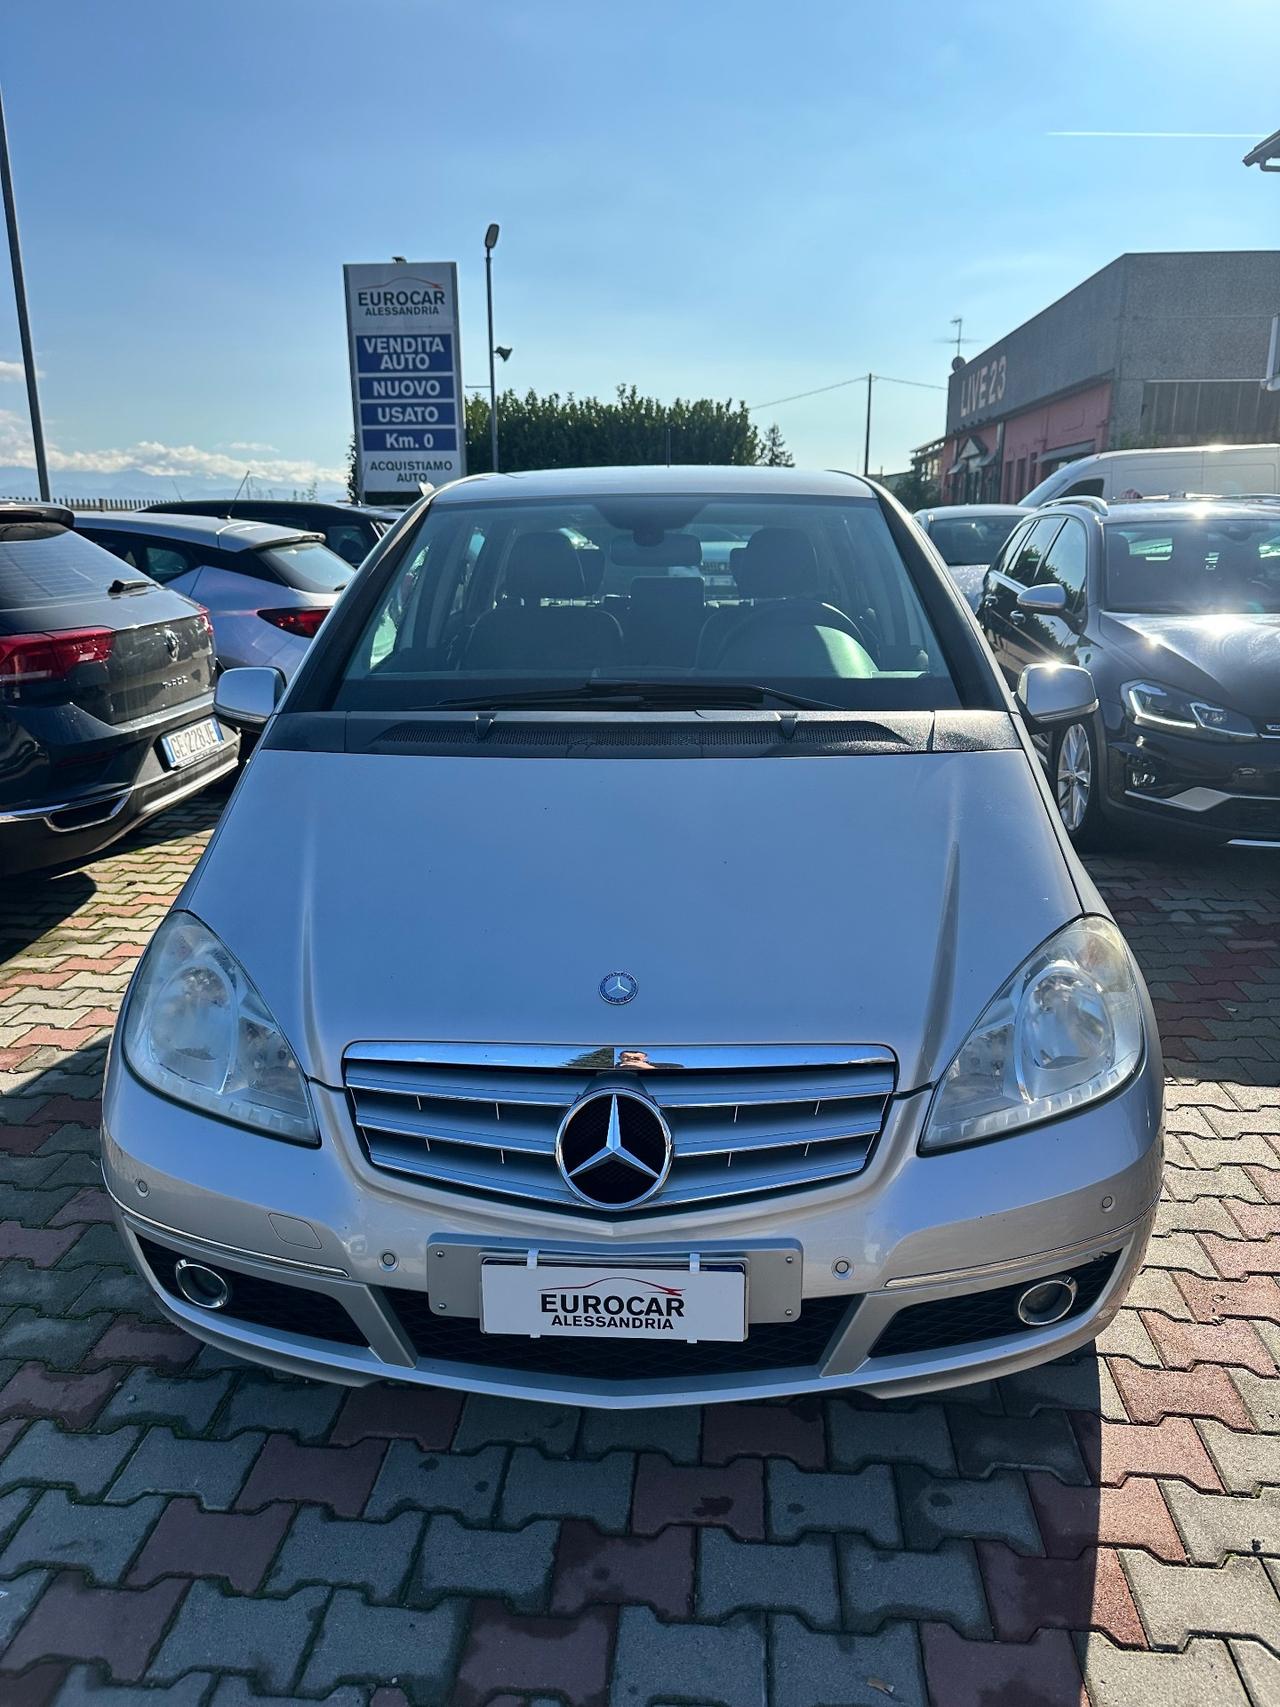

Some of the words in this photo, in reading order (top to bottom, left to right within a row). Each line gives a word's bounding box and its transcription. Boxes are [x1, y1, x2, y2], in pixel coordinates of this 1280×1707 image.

[358, 290, 445, 306] EUROCAR
[365, 305, 440, 316] ALESSANDRIA
[363, 336, 445, 354] VENDITA
[379, 354, 430, 370] AUTO
[372, 380, 441, 397] NUOVO
[377, 406, 439, 423] USATO
[385, 433, 419, 449] Km.
[423, 433, 434, 448] 0
[370, 460, 453, 472] ACQUISTIAMO
[396, 472, 428, 483] AUTO
[541, 1294, 685, 1317] EUROCAR
[551, 1315, 674, 1330] ALESSANDRIA
